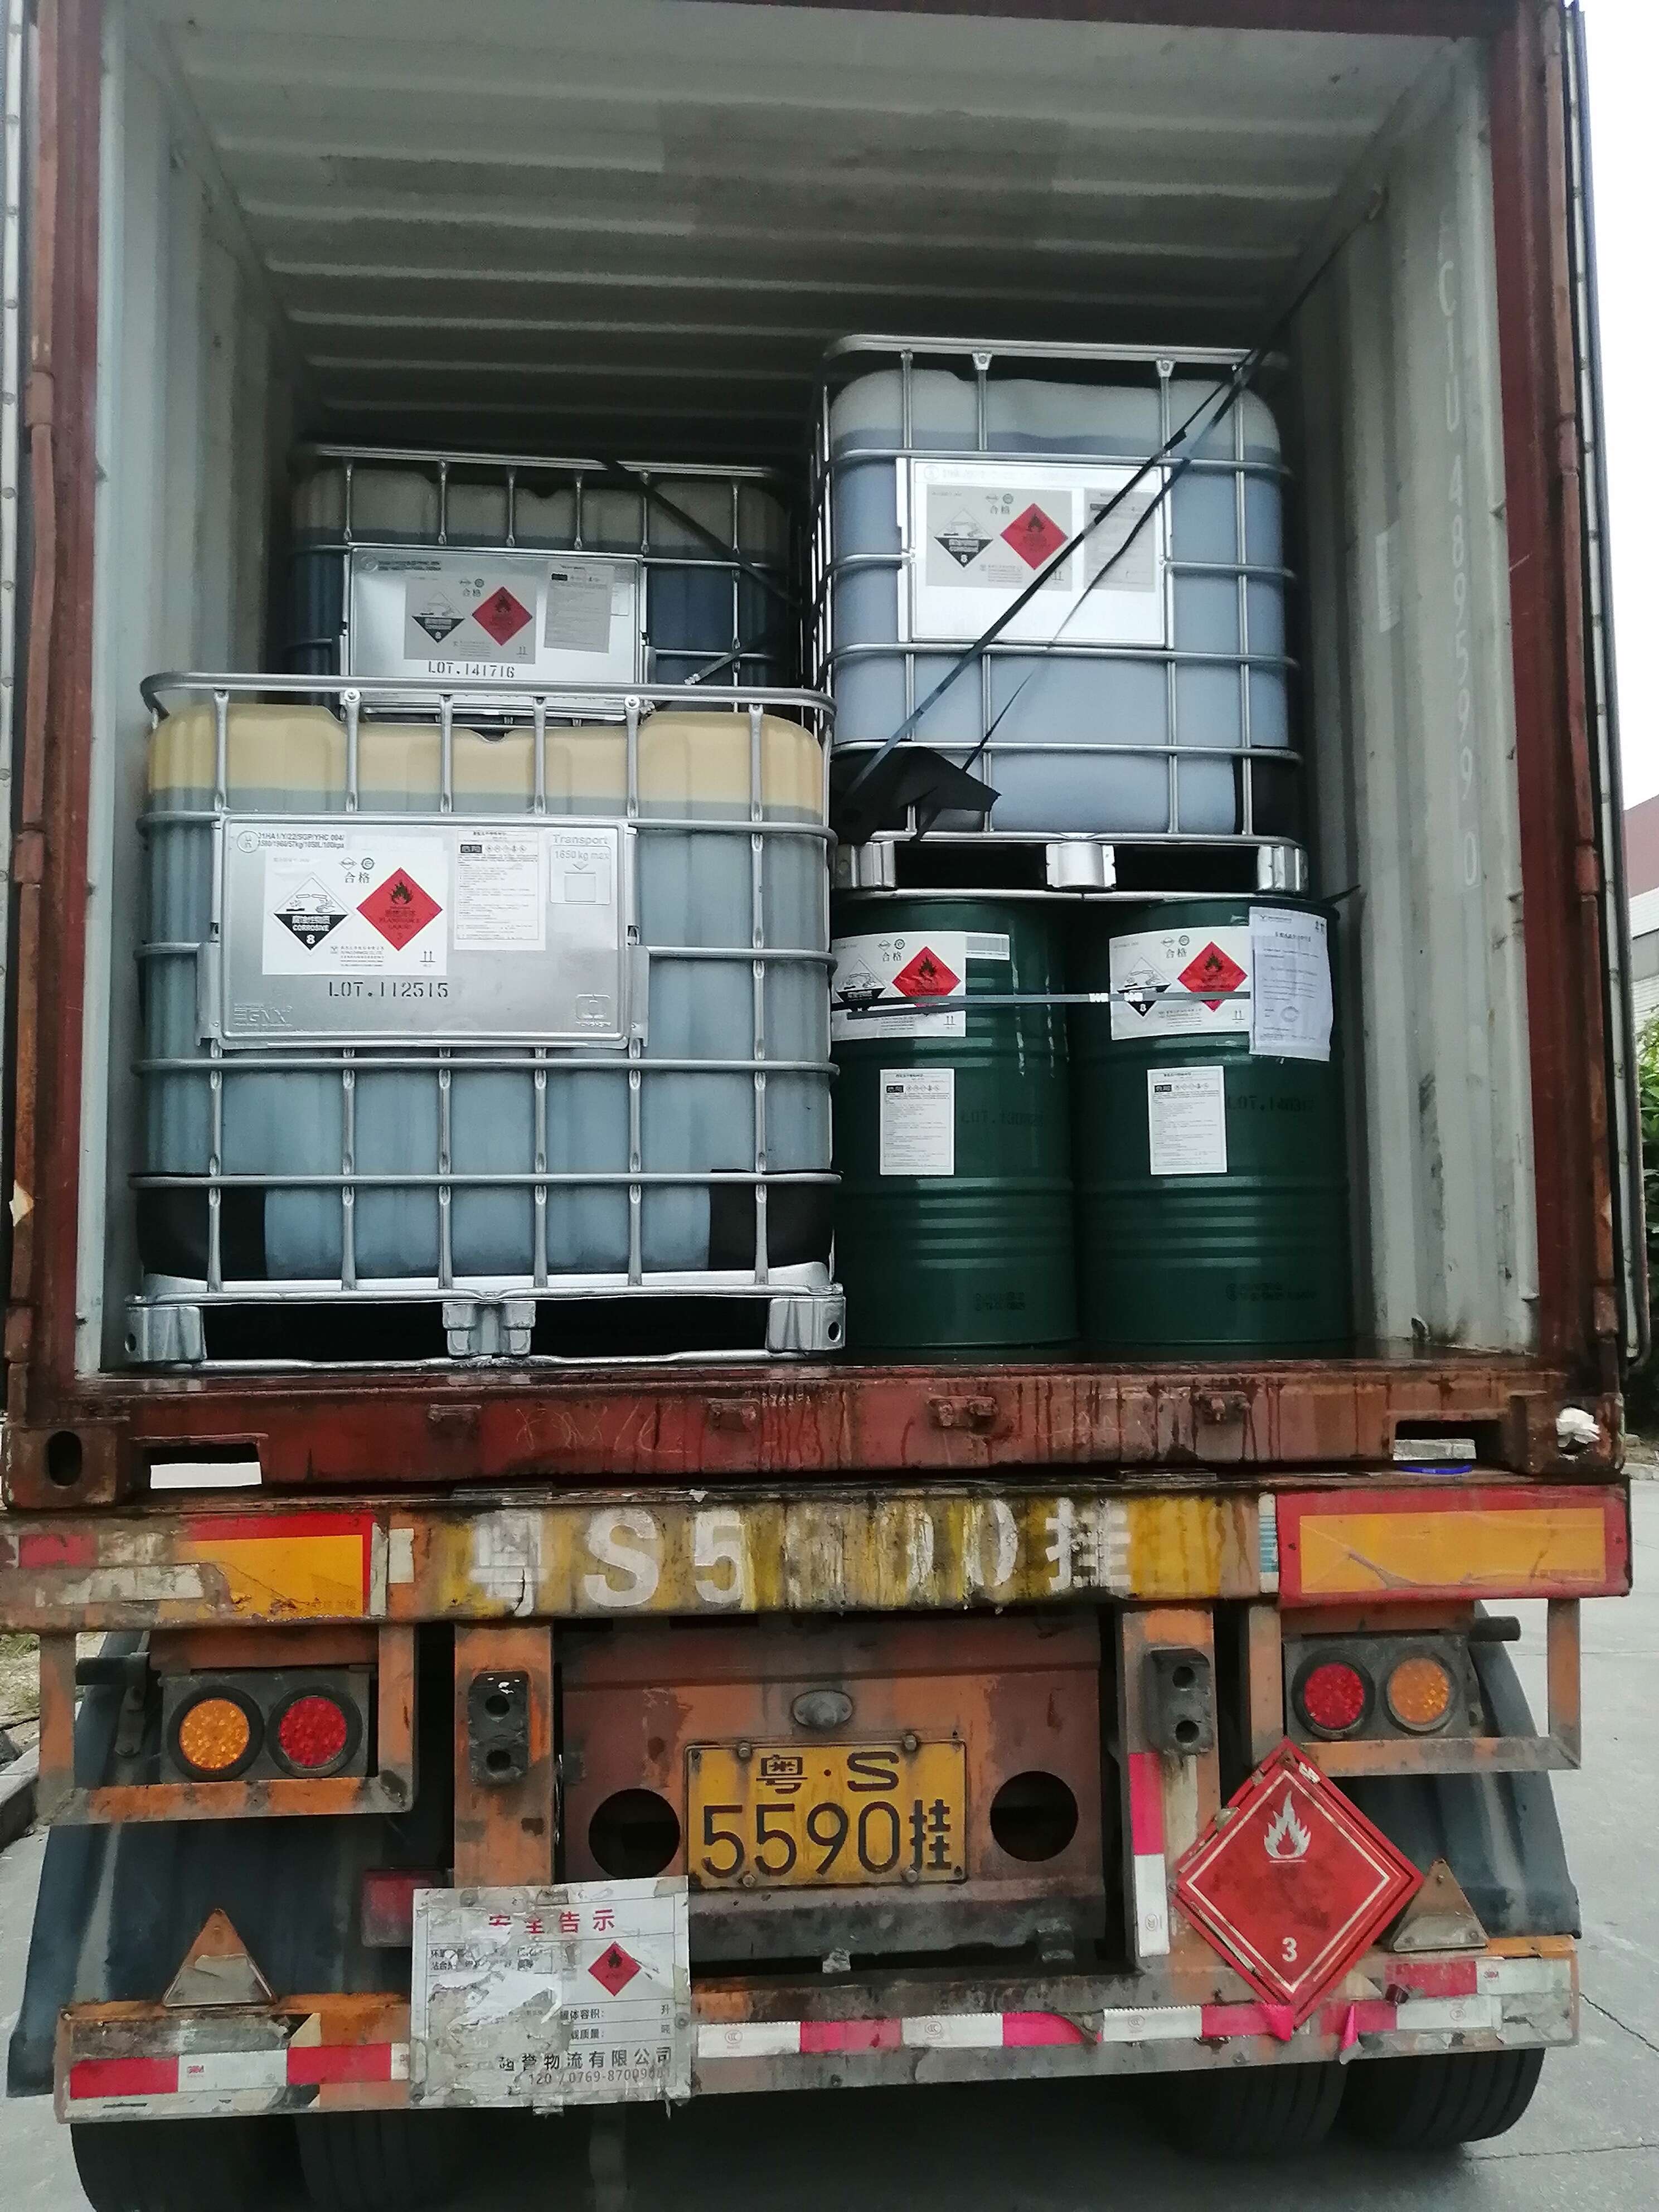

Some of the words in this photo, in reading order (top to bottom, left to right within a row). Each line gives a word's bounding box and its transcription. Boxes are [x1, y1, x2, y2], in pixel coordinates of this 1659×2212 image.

[552, 834, 608, 845] Transport
[578, 851, 589, 861] kg
[345, 871, 370, 884] 合格
[306, 934, 316, 944] 8
[328, 981, 449, 997] LOT.112515
[1139, 1003, 1147, 1012] 8
[701, 1799, 952, 1879] 5590挂
[1282, 1937, 1297, 1962] 3
